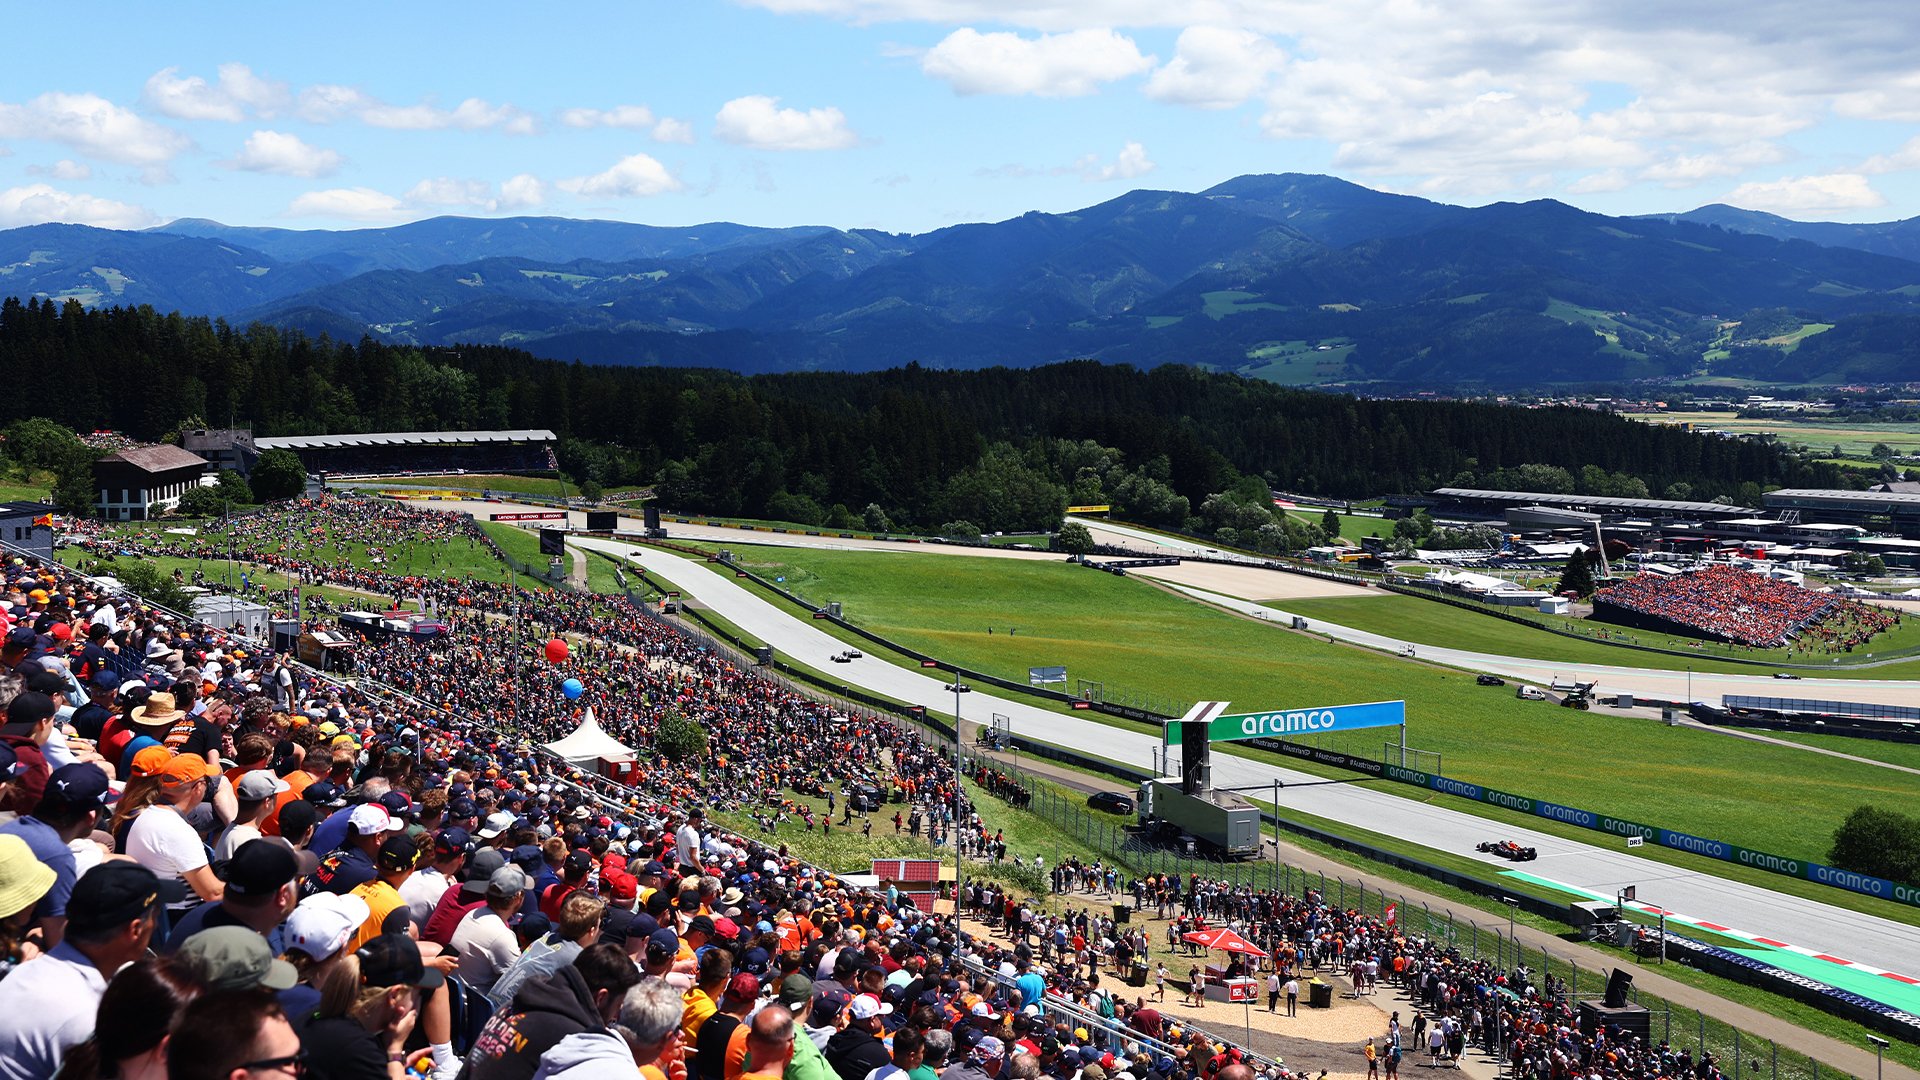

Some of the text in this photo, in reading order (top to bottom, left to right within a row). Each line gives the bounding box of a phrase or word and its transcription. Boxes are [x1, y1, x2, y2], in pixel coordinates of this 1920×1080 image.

[1241, 710, 1335, 735] aramco
[1389, 766, 1426, 784] aramco
[1436, 778, 1476, 797] aramco
[1488, 790, 1530, 811] aramco
[1543, 804, 1590, 825] aramco
[1604, 818, 1653, 840] aramco
[1629, 838, 1642, 846] DRS
[1669, 833, 1722, 856] aramco
[1739, 850, 1798, 874] aramco
[1817, 867, 1882, 894] aramco
